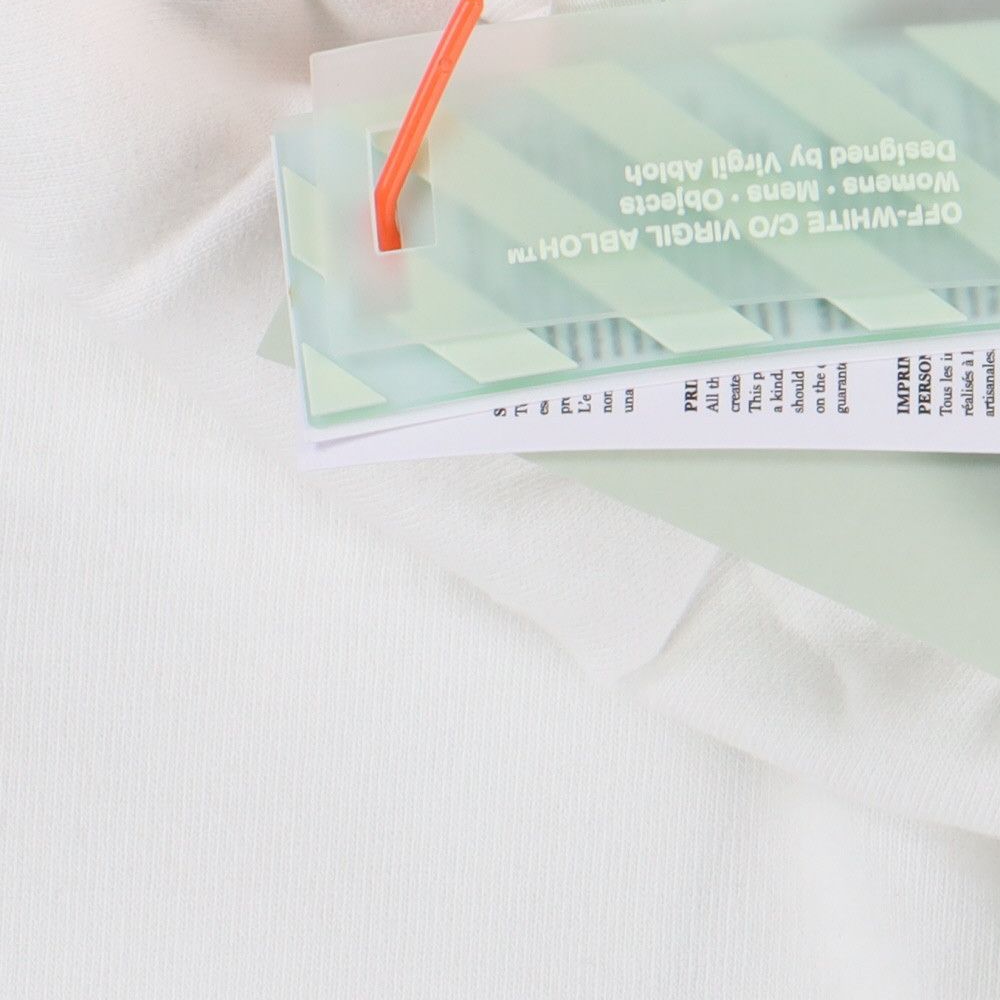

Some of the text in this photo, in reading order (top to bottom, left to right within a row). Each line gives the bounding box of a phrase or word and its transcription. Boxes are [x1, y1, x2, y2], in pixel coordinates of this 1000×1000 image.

[624, 137, 958, 186] Designed by Virgil Abloh
[746, 178, 820, 203] Mens
[842, 170, 961, 195] Womens
[618, 186, 725, 217] Objects
[507, 201, 963, 265] OFF-WHITE C/O VIRGIL ABLOH™
[812, 373, 826, 393] the
[940, 365, 953, 383] les
[706, 393, 719, 413] All
[749, 384, 762, 414] This
[791, 370, 805, 413] should
[940, 386, 953, 416] Tous
[961, 372, 974, 416] réalisés
[816, 401, 826, 414] on
